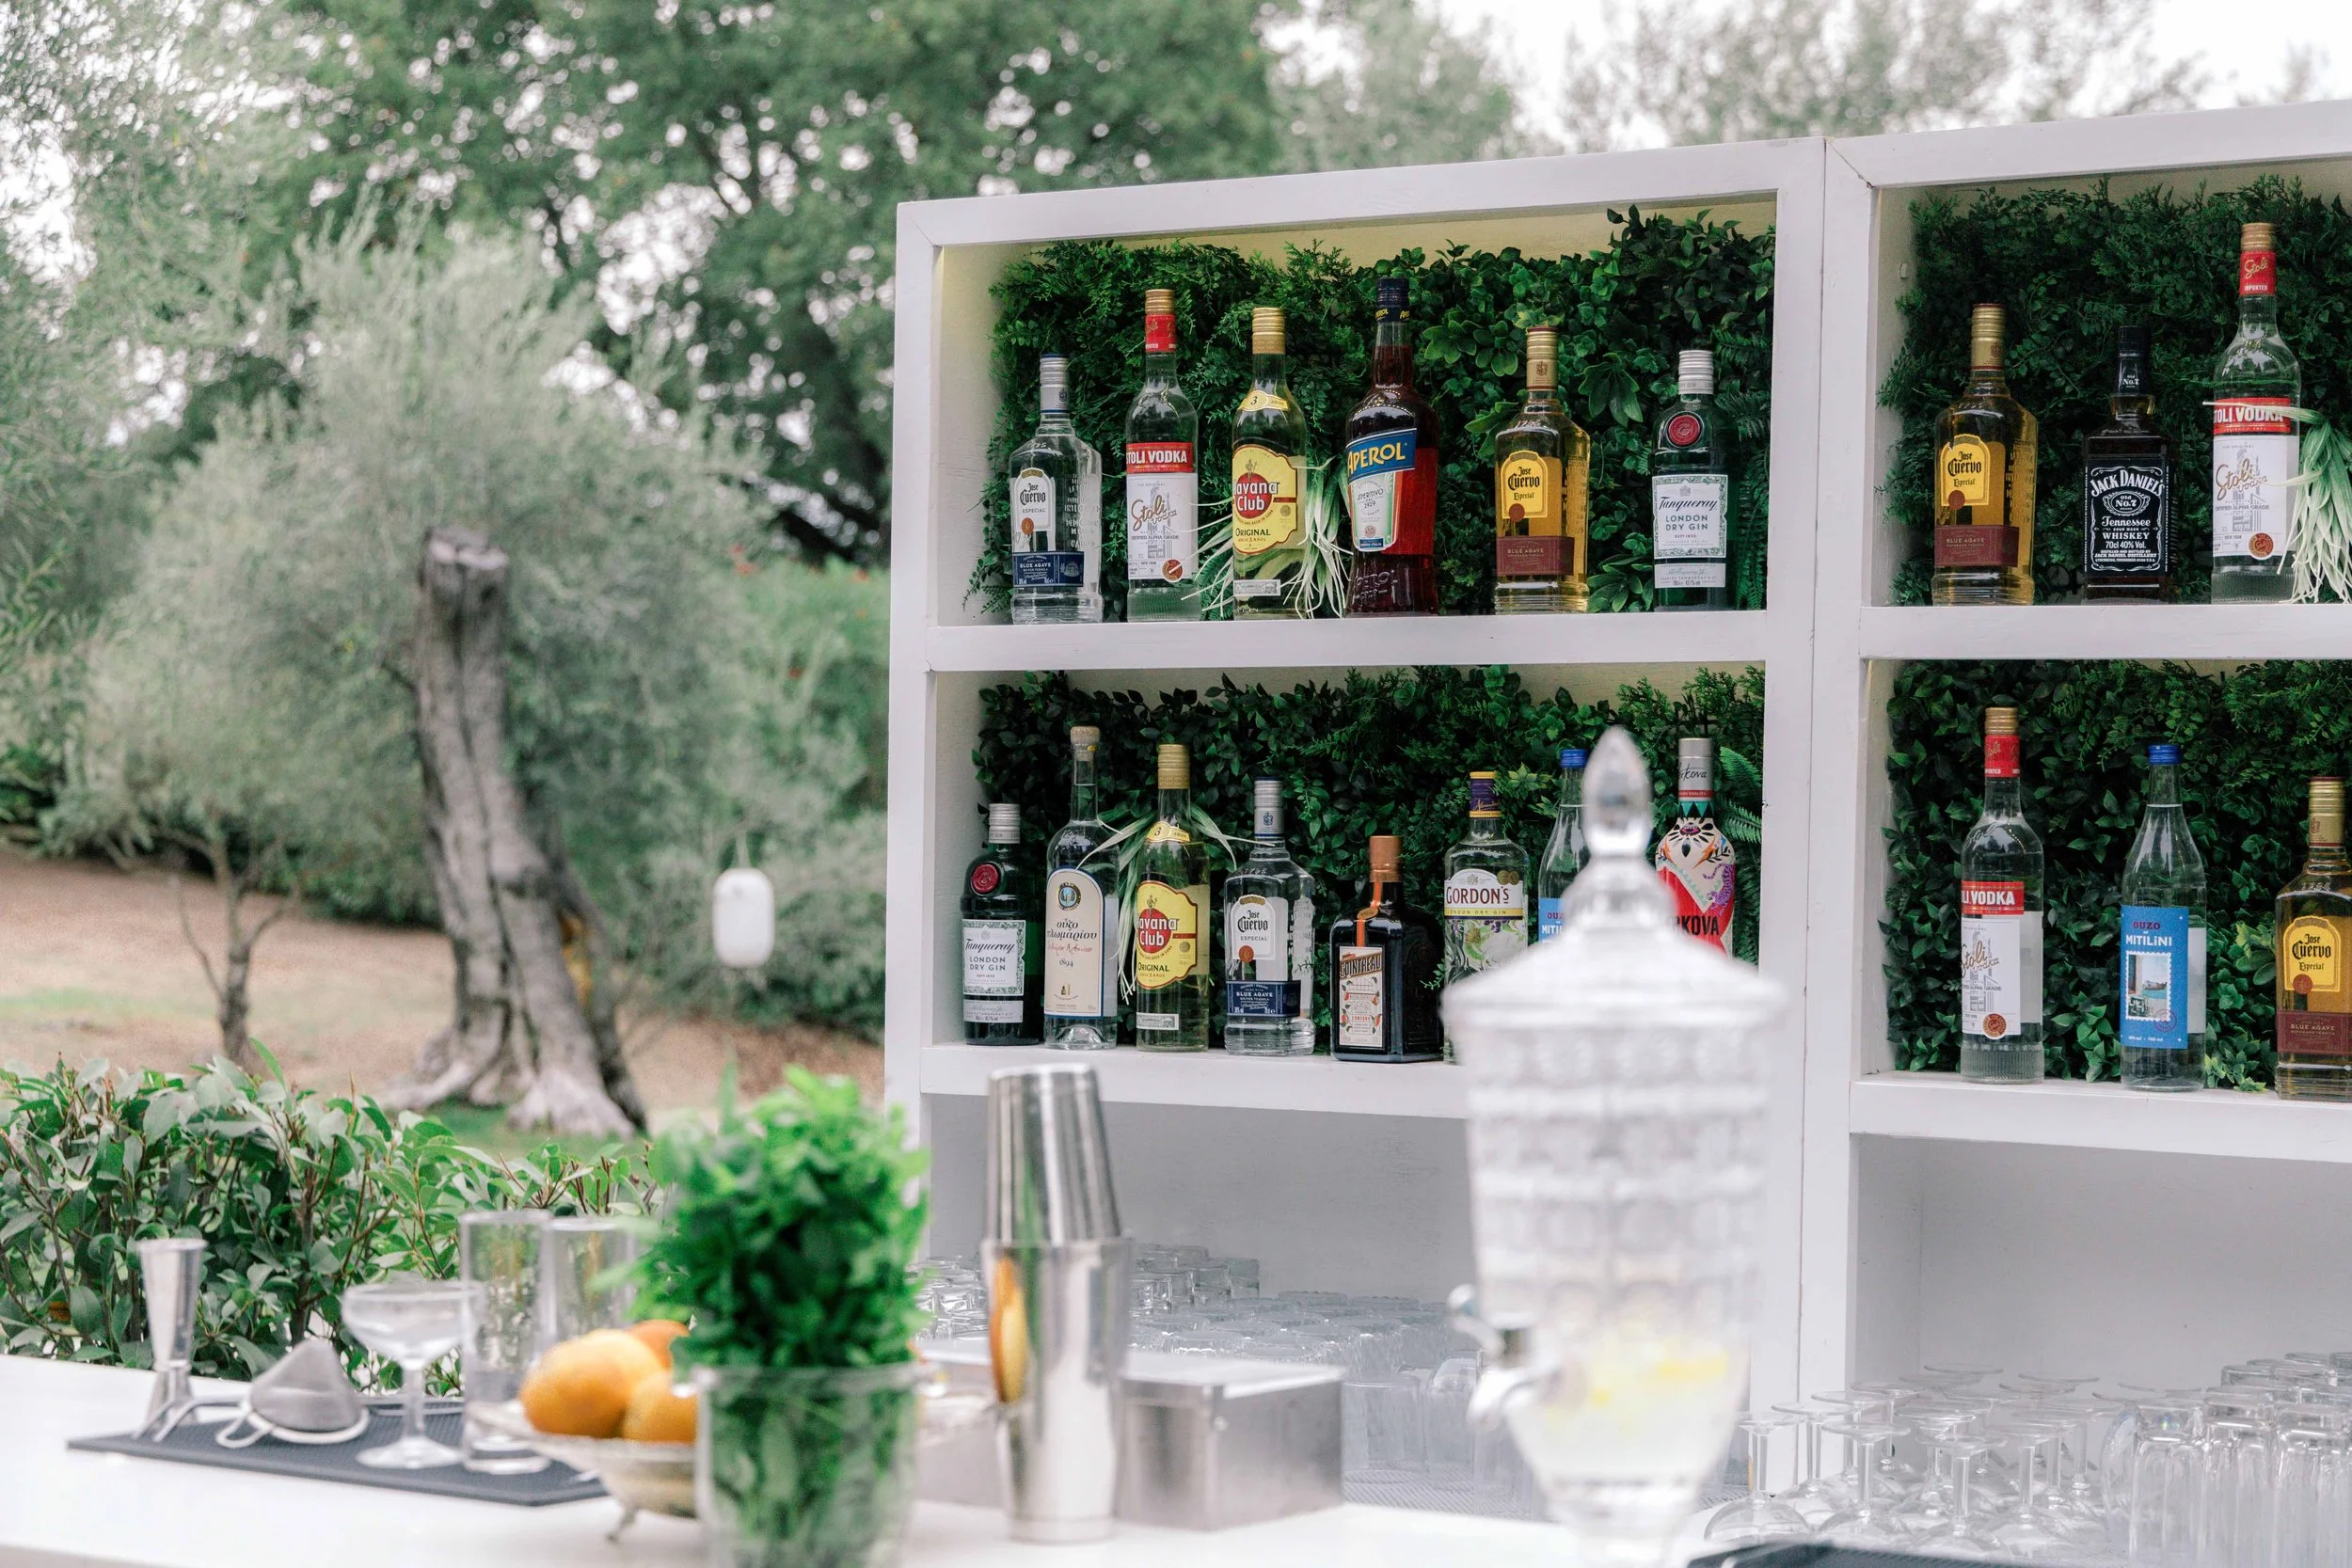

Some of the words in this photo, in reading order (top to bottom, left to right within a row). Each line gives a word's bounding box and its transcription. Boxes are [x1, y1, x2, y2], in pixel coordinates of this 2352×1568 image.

[2245, 257, 2267, 278] Stoli
[1250, 396, 1258, 405] 3
[1148, 450, 1187, 464] VODKA
[1347, 442, 1406, 477] APEROL
[1958, 451, 1973, 462] Jose
[1518, 467, 1532, 477] Jose
[1947, 458, 1981, 477] Cuervo
[1508, 473, 1540, 491] Cuervo
[1954, 478, 1976, 487] Especial
[2090, 474, 2119, 497] JACK
[2120, 469, 2165, 497] DANIEL'S
[2216, 458, 2253, 500] Stoli
[2237, 475, 2267, 493] vodka
[1027, 483, 1039, 492] Jose
[1358, 488, 1384, 501] APERITIVO
[1020, 489, 1046, 506] Cuervo
[1514, 492, 1534, 500] Especial
[1236, 496, 1265, 512] Club
[1659, 497, 1718, 511] Tanqueray
[1131, 494, 1168, 532] Stoli
[1152, 511, 1177, 524] vodka
[1665, 515, 1708, 523] LONDON
[2102, 515, 2151, 527] Tennessee
[1235, 528, 1270, 536] ORIGINAL
[2103, 531, 2150, 540] WHISKEY
[2135, 541, 2147, 549] Vol.
[1153, 827, 1161, 836] 3
[1446, 885, 1509, 904] GORDON'S
[1970, 890, 2015, 905] VODKA
[1248, 910, 1260, 920] Jose
[1237, 915, 1268, 933] Cuervo
[2133, 921, 2161, 930] OUZO
[1139, 930, 1165, 946] Club
[2304, 933, 2321, 944] Jose
[965, 938, 1015, 954] Tanqueray
[2292, 941, 2331, 959] Cuervo
[1137, 961, 1169, 972] ORIGINAL
[1340, 954, 1382, 979] COINTREAU
[1973, 957, 2000, 974] vodka
[2299, 962, 2325, 972] Especial
